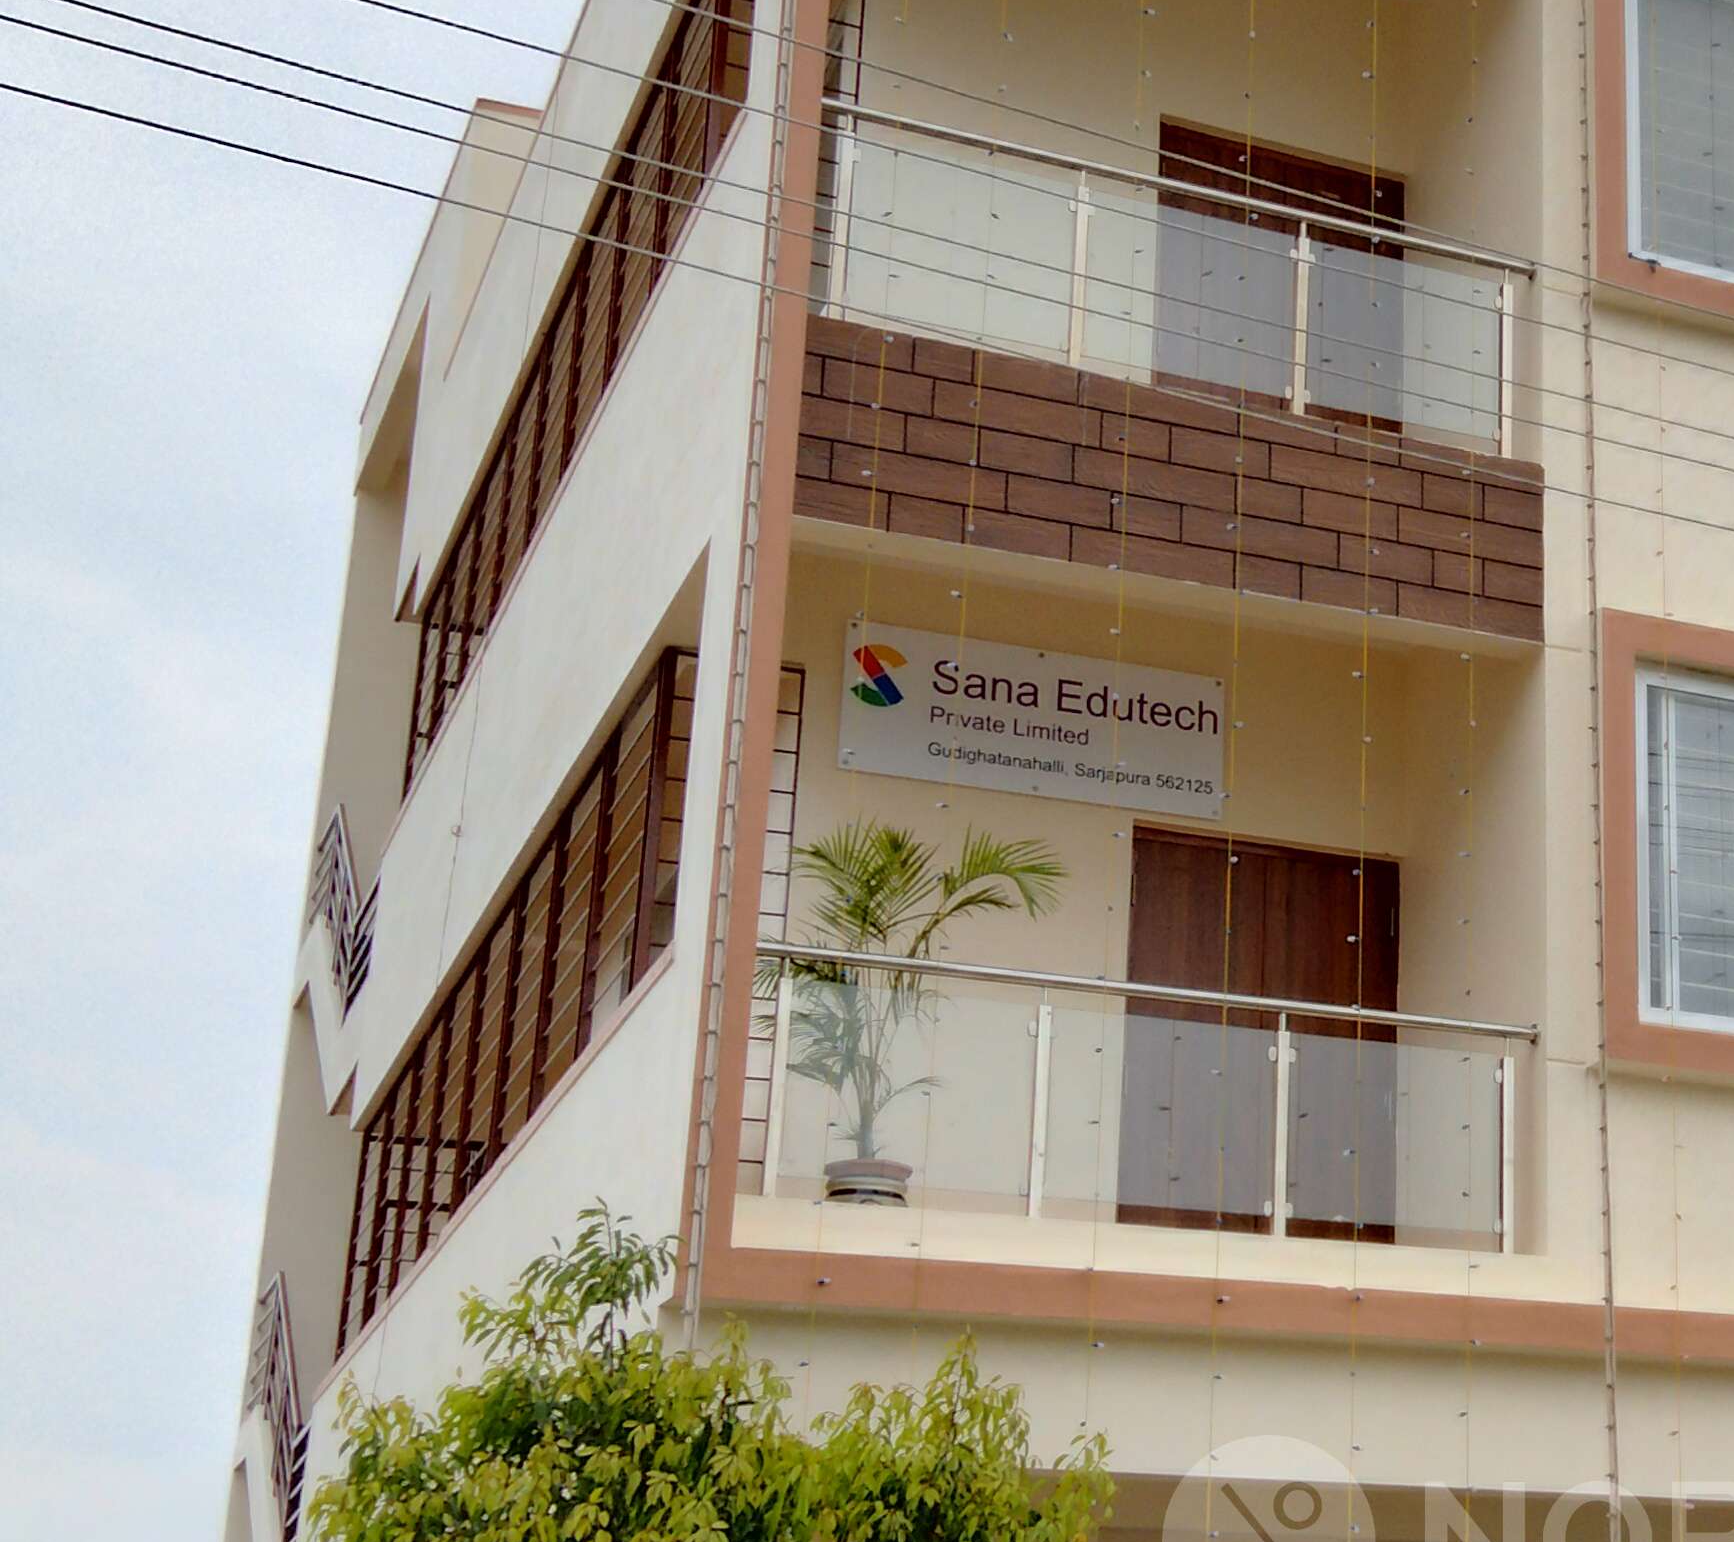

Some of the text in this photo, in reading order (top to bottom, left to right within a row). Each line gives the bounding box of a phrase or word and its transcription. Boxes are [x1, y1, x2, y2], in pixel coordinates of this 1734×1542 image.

[932, 660, 1218, 735] Sana Edutech
[930, 705, 1089, 746] Private Limited
[1074, 762, 1151, 786] Sarjapura
[1156, 773, 1214, 795] 562125
